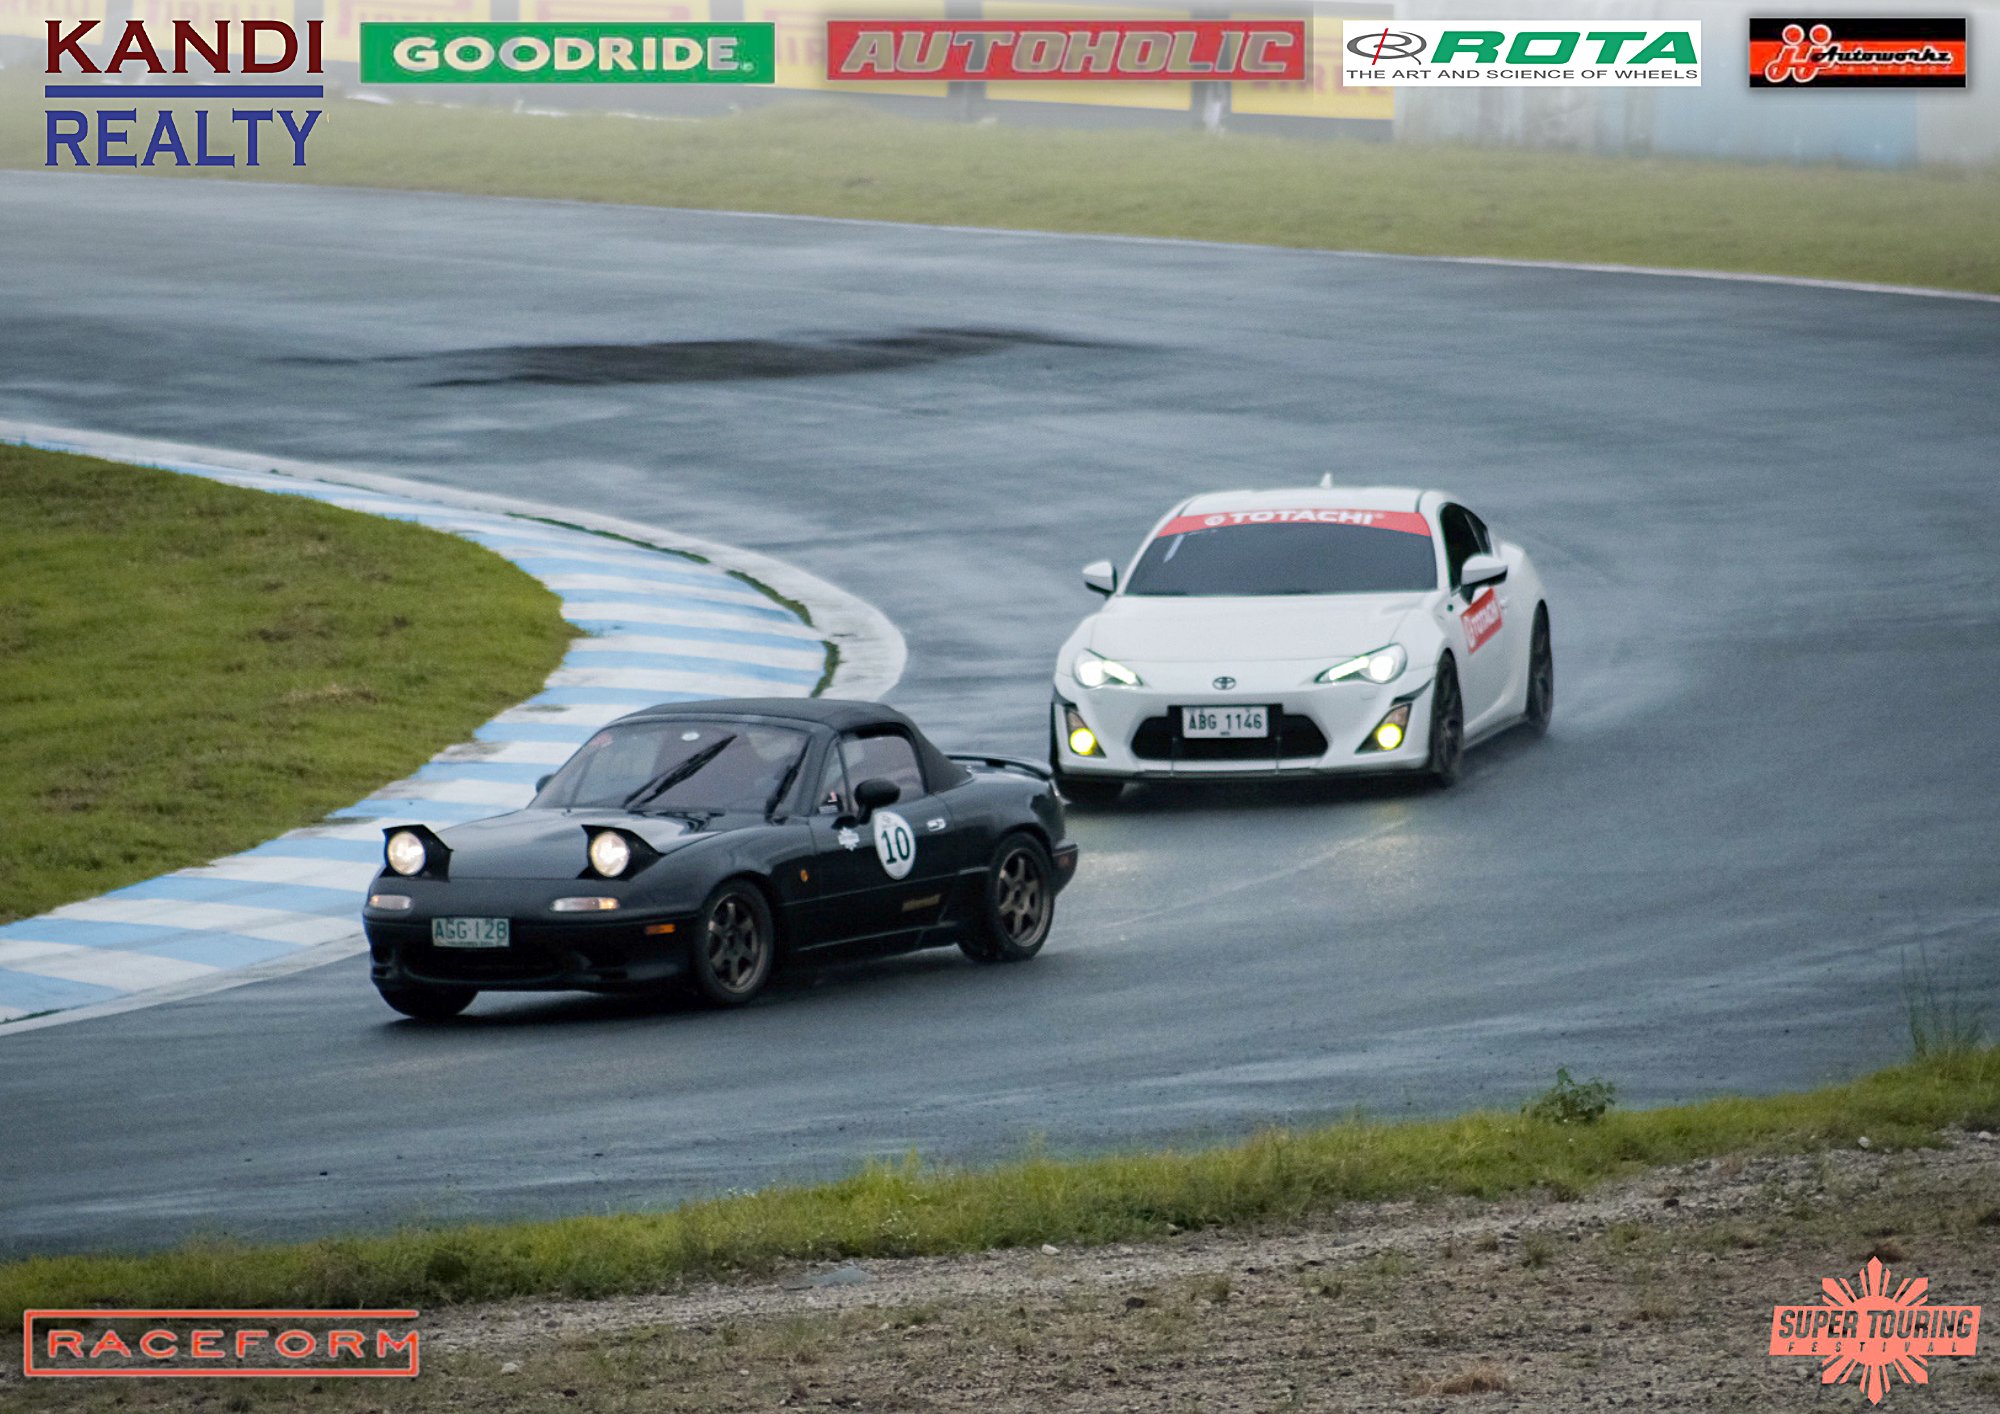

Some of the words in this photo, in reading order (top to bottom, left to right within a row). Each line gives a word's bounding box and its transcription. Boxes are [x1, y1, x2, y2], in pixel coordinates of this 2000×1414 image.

[1230, 510, 1374, 525] TOTACHI
[1189, 713, 1217, 730] ABG
[1226, 713, 1262, 730] 1146
[881, 826, 911, 865] 10
